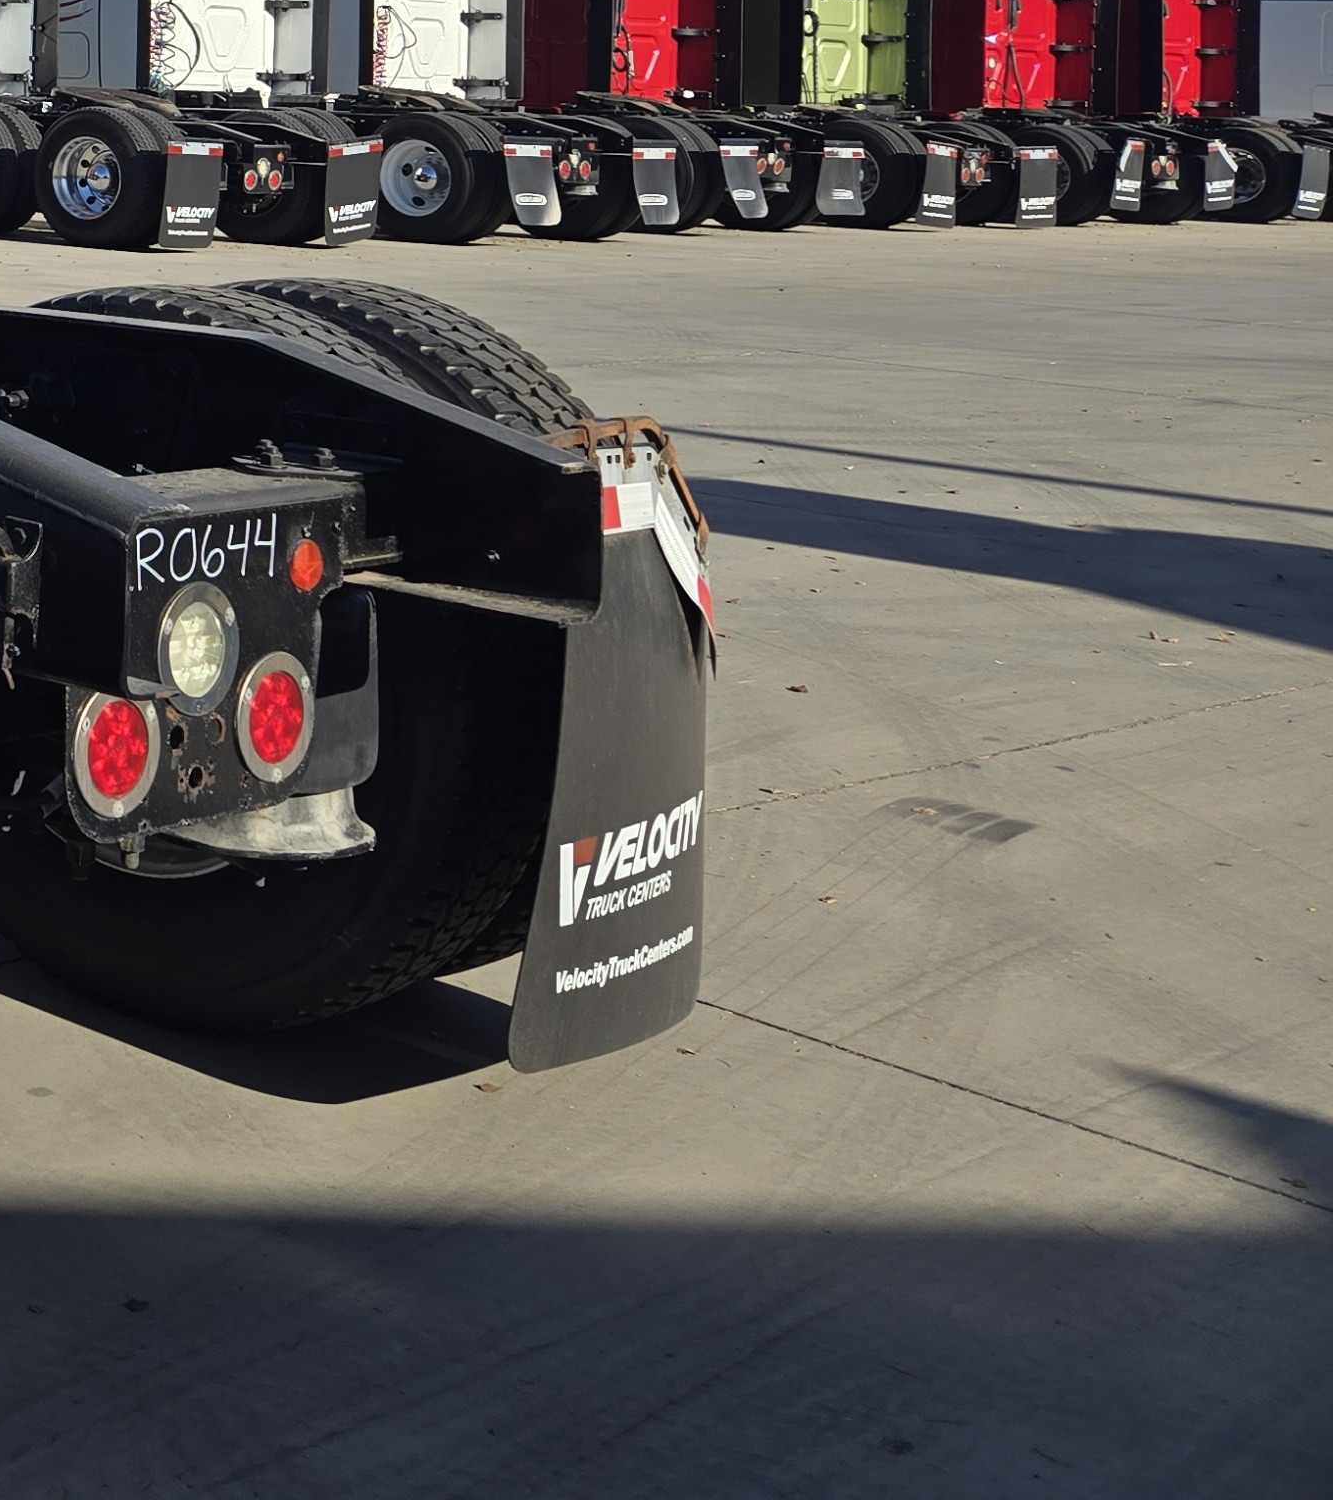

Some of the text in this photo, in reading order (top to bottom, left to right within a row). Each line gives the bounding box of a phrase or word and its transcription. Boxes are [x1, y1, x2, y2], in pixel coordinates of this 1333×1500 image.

[593, 790, 704, 887] VELOCITY
[585, 870, 672, 921] TRUCK CENTERS
[555, 925, 694, 994] VelocityTruckCenters.com
